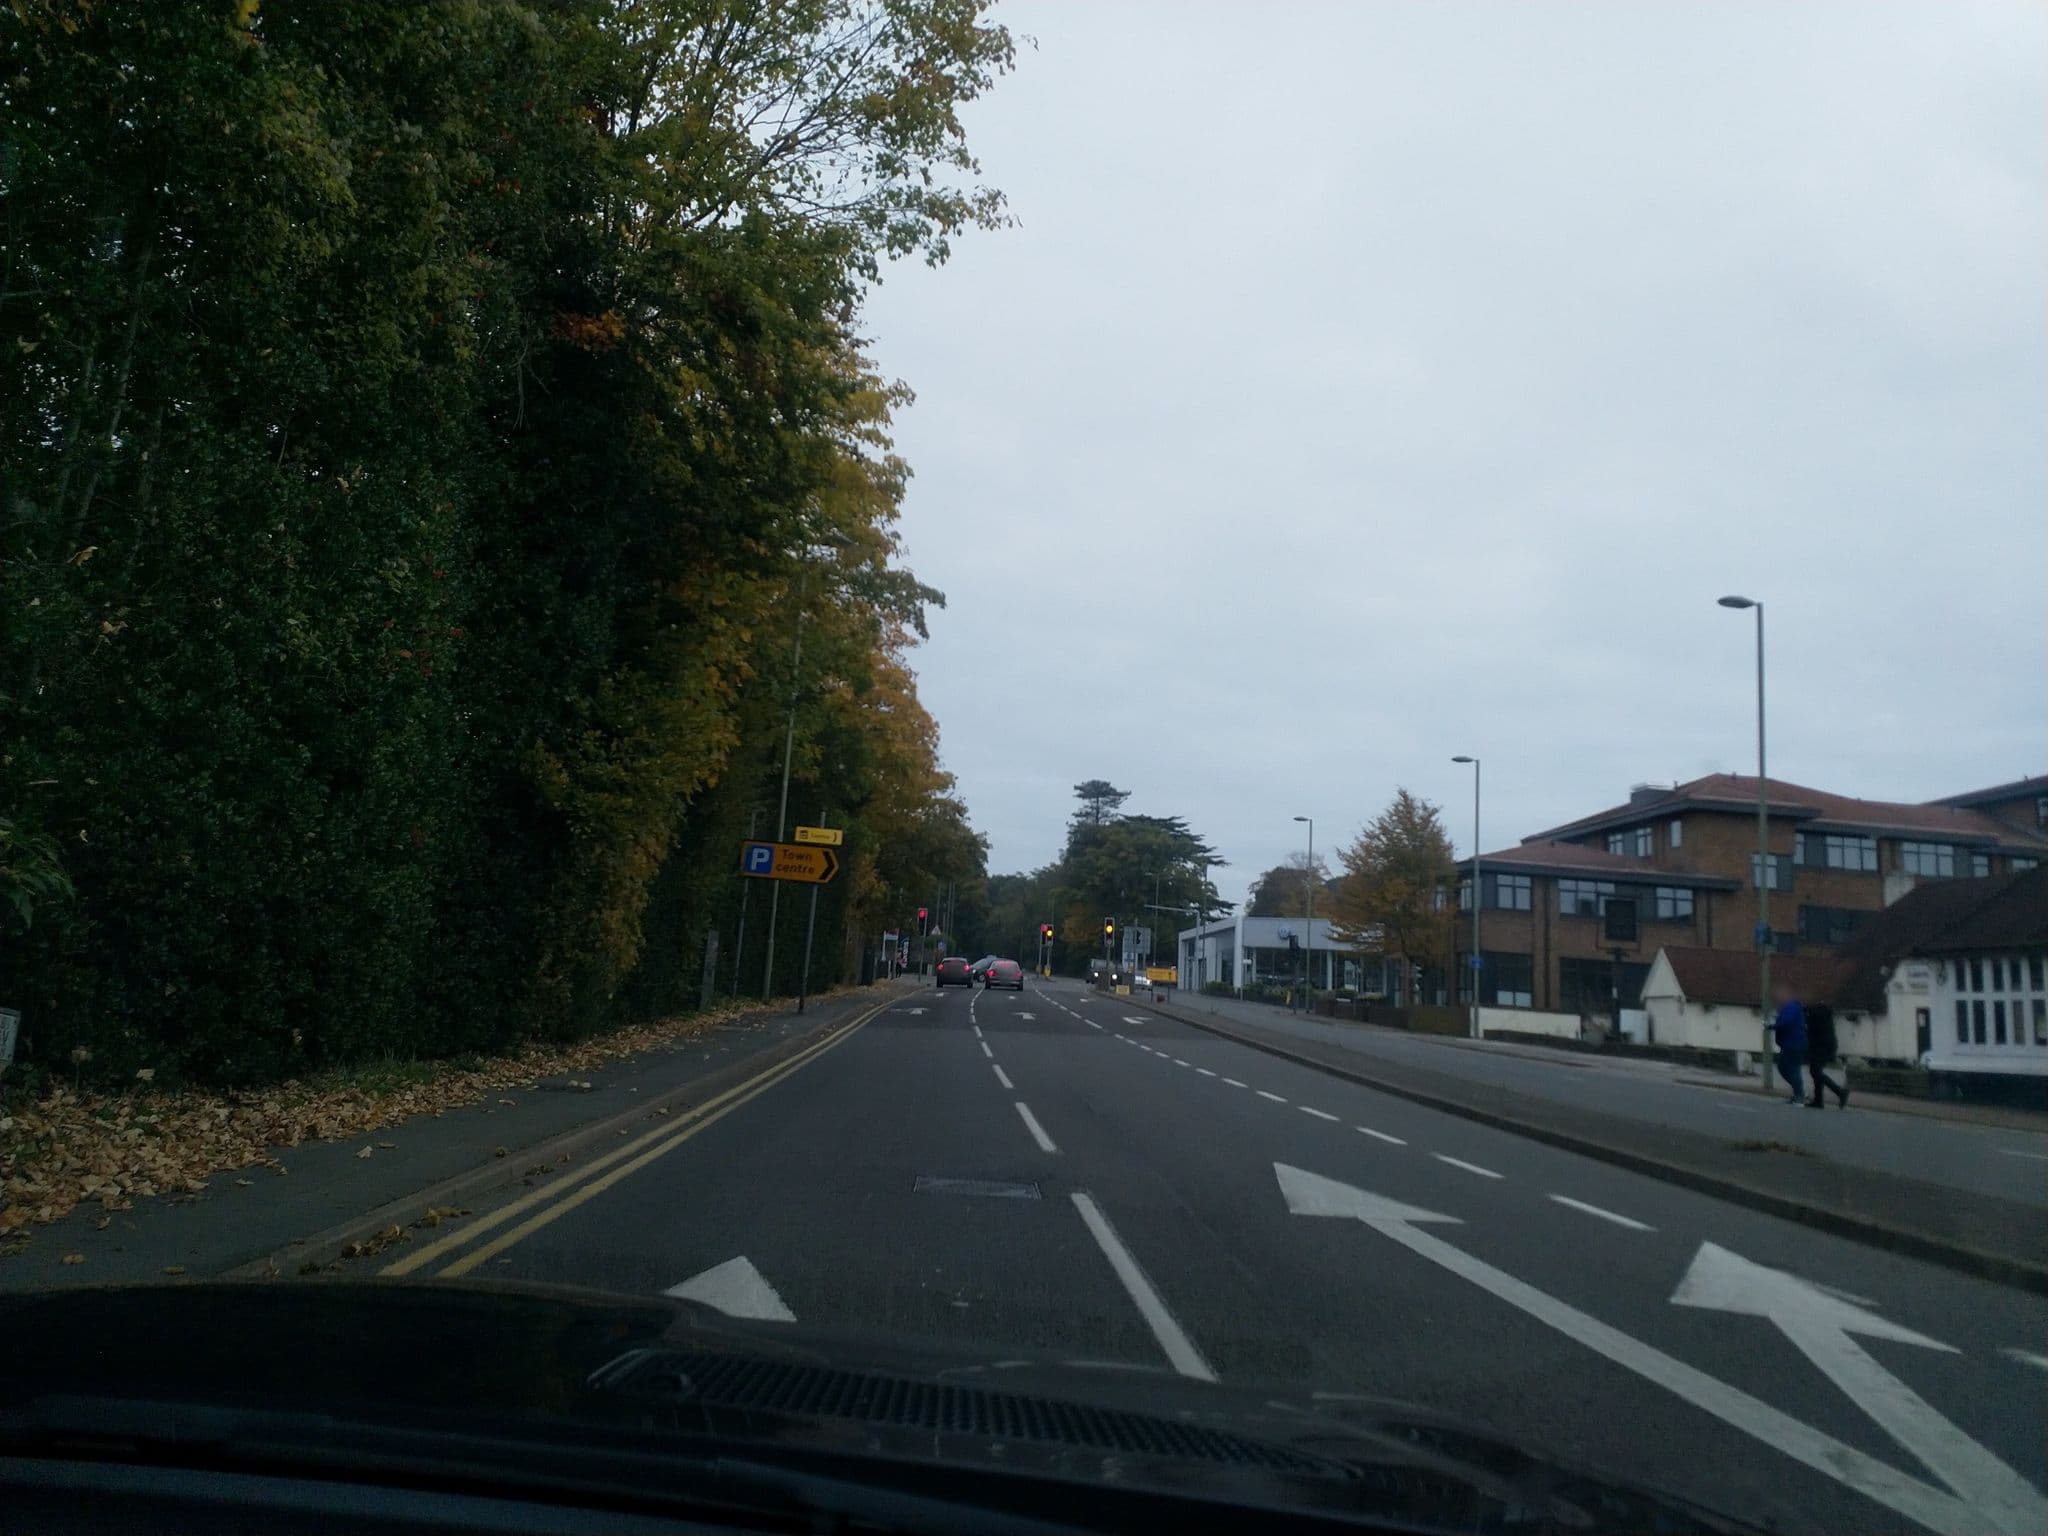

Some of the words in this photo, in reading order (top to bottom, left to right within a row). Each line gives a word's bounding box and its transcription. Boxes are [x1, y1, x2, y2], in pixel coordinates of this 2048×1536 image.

[751, 848, 770, 870] P
[783, 849, 812, 860] Town
[776, 864, 815, 874] centre
